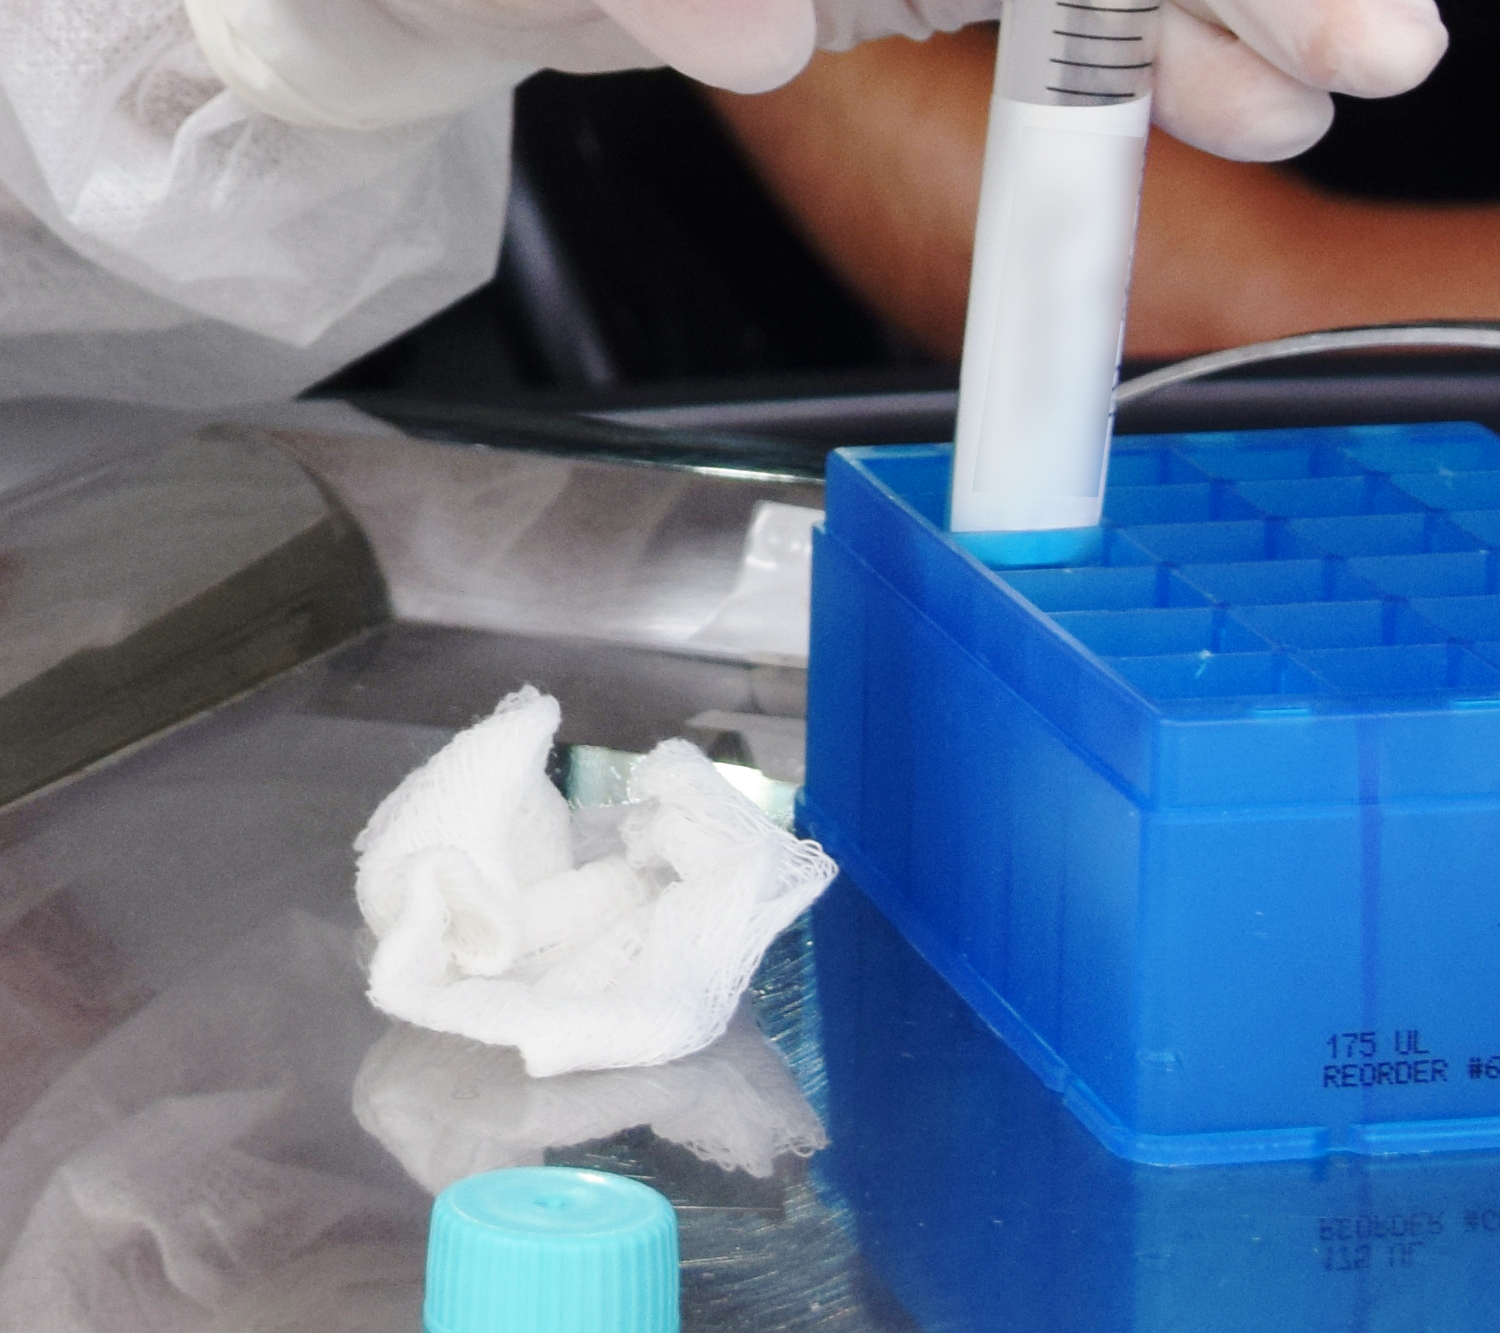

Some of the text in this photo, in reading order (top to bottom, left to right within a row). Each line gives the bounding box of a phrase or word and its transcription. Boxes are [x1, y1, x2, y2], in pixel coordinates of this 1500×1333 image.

[1326, 1030, 1430, 1059] 175 UL
[1323, 1058, 1449, 1088] REORDER
